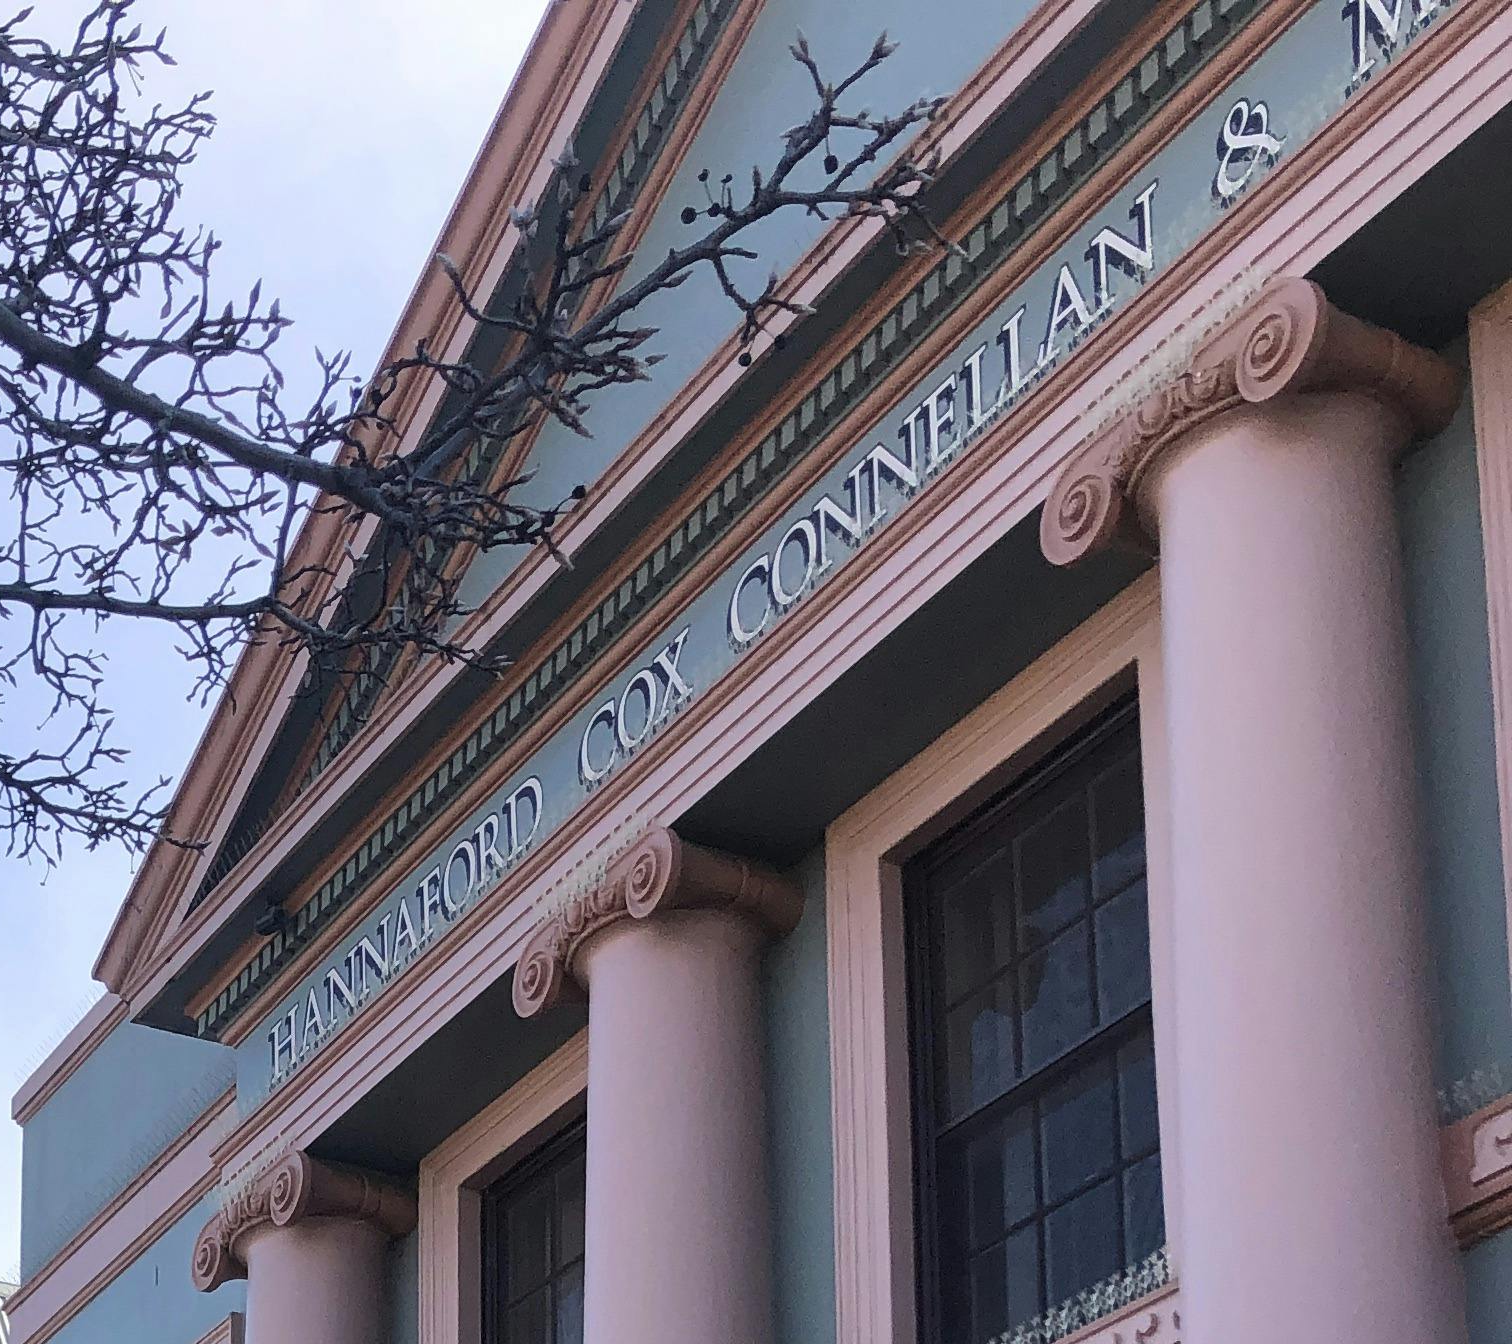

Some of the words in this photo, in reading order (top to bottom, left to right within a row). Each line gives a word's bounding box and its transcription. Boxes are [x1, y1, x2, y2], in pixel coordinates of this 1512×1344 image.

[270, 774, 545, 1081] HANNAFORD
[578, 625, 694, 785] COX
[727, 178, 1159, 647] CONNELLAN
[1215, 97, 1287, 199] &
